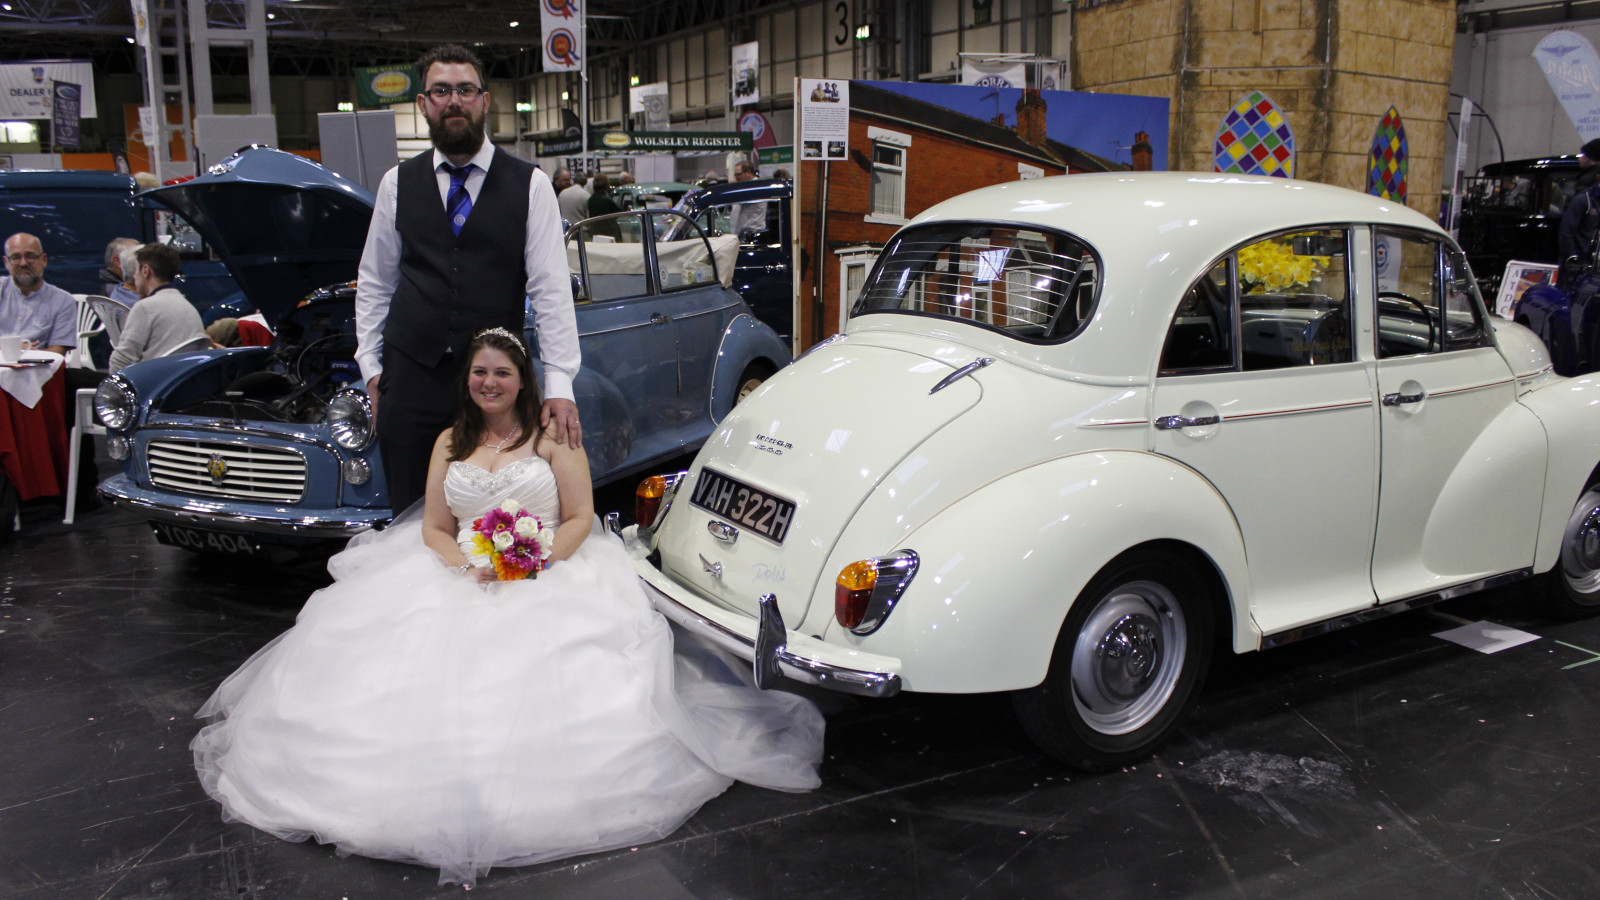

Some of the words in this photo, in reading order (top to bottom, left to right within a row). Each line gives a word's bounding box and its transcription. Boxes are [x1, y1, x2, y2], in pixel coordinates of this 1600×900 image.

[835, 1, 848, 46] 3
[10, 88, 45, 97] DEALER
[977, 77, 1011, 88] ORR
[634, 136, 689, 147] WOLSELEY
[691, 136, 742, 147] REGISTER
[697, 472, 736, 514] VAH
[731, 488, 792, 540] 322H
[160, 525, 203, 549] YOC
[208, 533, 253, 554] 404
